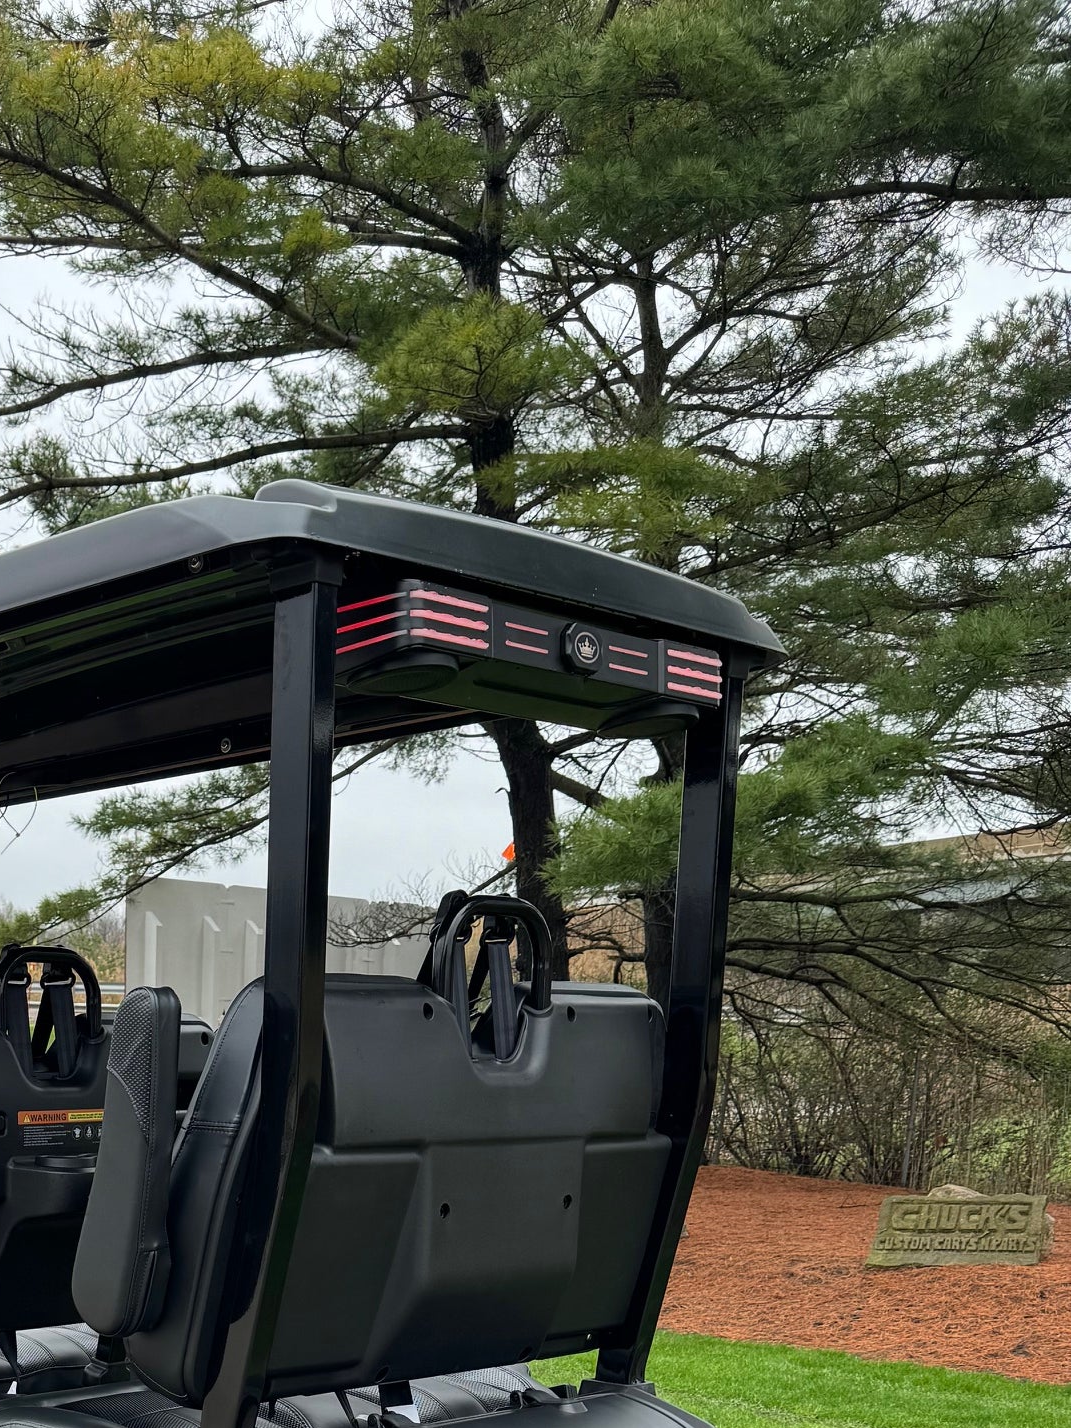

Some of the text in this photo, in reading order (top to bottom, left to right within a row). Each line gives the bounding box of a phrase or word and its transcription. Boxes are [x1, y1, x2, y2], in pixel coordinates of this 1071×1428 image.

[30, 1113, 67, 1122] WARNING
[892, 1204, 1029, 1231] CHUCK'S
[875, 1237, 930, 1251] CUSTOM
[933, 1237, 979, 1252] CARTS
[990, 1237, 1037, 1253] PARTS
